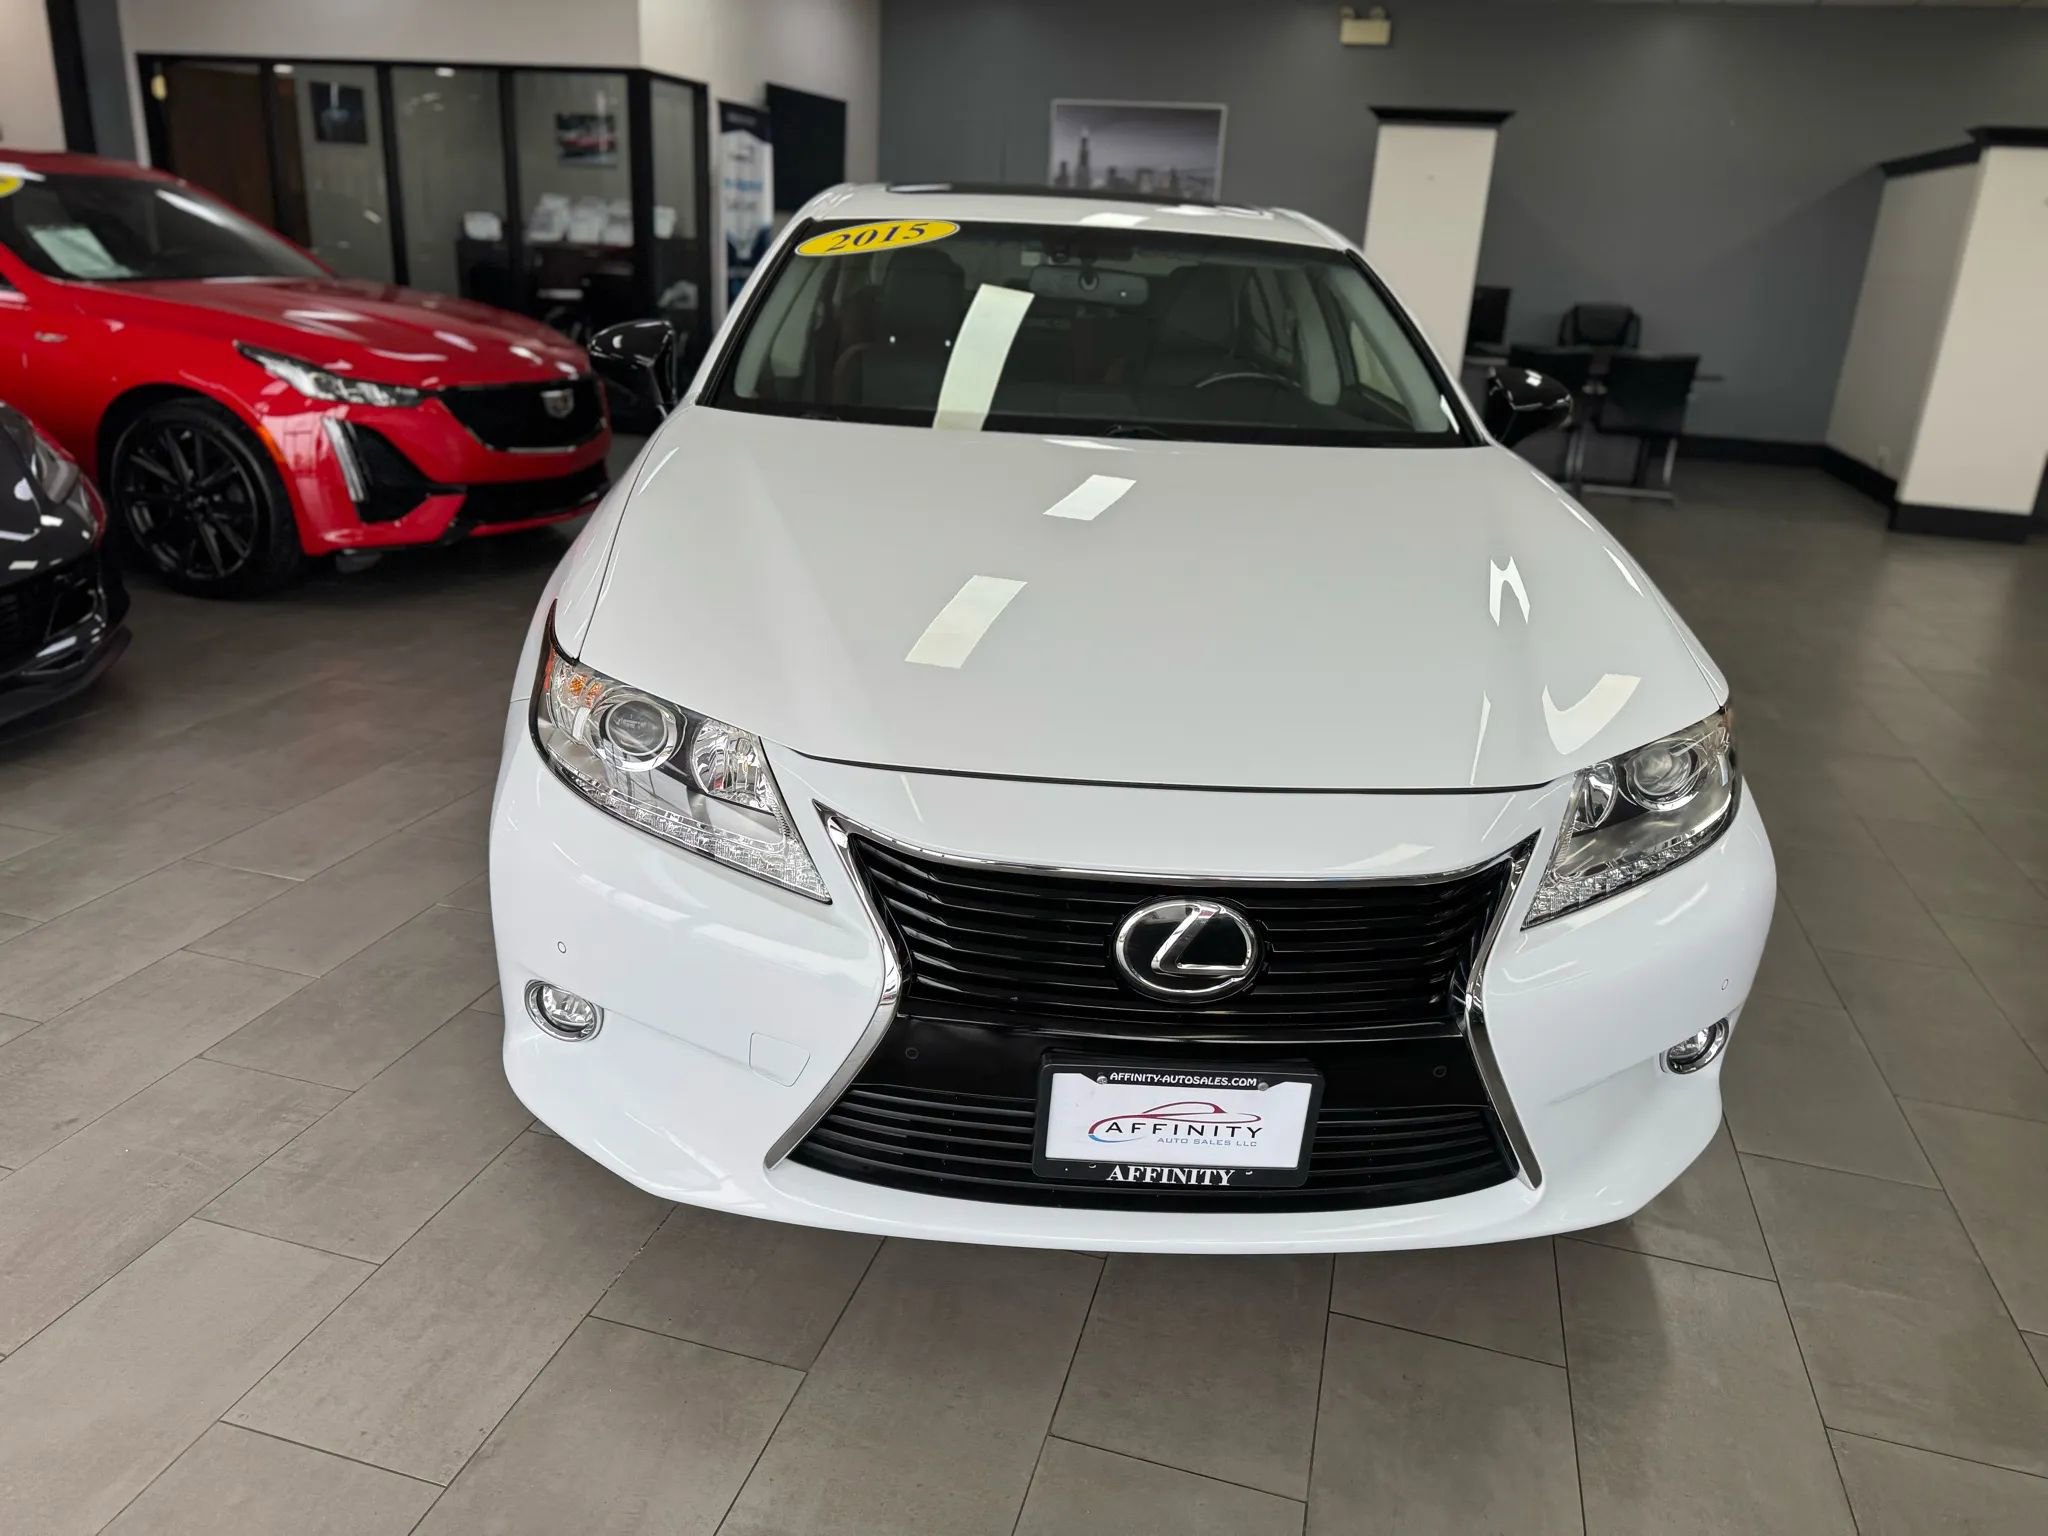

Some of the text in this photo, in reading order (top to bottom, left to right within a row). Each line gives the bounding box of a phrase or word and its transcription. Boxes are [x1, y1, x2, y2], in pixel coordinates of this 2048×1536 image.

[824, 222, 928, 252] 2015
[1109, 1072, 1257, 1087] AFFINITY-AUTOSALES.COM
[1105, 1121, 1263, 1138] AFFINITY
[1157, 1136, 1258, 1148] AUTO SALES LLC
[1106, 1164, 1235, 1186] AFFINITY
